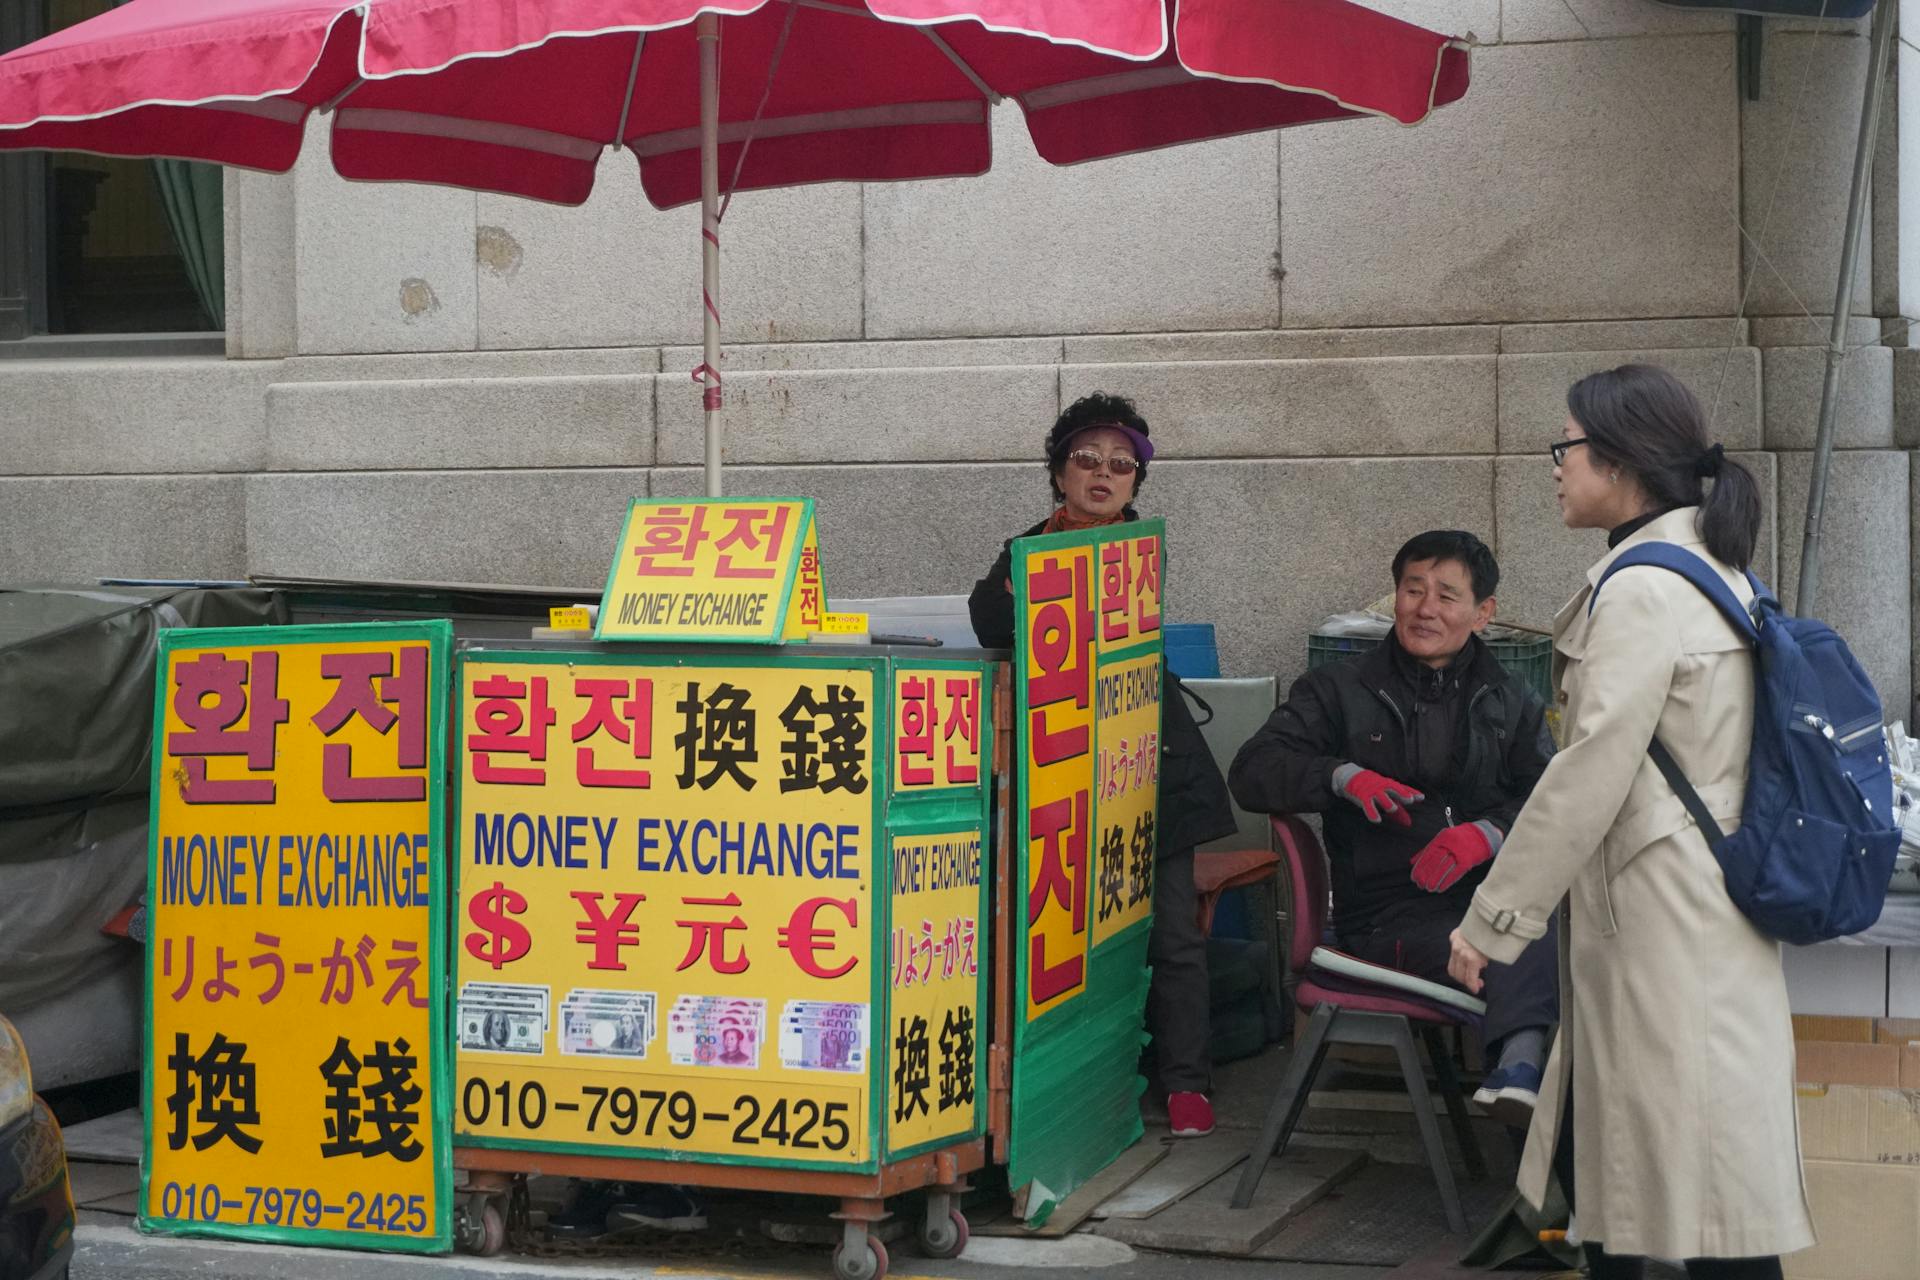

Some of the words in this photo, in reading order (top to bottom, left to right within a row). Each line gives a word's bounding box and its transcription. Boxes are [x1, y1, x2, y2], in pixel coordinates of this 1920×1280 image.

[634, 505, 791, 579] 환전
[618, 592, 678, 625] MONEY
[679, 593, 768, 626] EXCHANGE
[800, 547, 819, 624] 환전
[1102, 536, 1160, 642] 환전
[168, 646, 428, 804] 환전
[1098, 672, 1124, 720] MONEY
[1127, 662, 1159, 711] EXCHANG
[468, 675, 653, 789] 환전
[899, 676, 979, 787] 환전
[1028, 555, 1095, 1005] 환전
[162, 834, 270, 906] MONEY
[278, 832, 429, 908] EXCHANGE
[475, 813, 618, 870] MONEY
[638, 818, 859, 879] EXCHANGE
[892, 847, 928, 896] MONEY
[932, 840, 981, 889] EXCHANGE
[465, 882, 532, 970] $
[675, 892, 750, 974] 元
[777, 897, 859, 979] €
[167, 1033, 424, 1161] 換錢
[895, 1006, 975, 1123] 換錢
[463, 1077, 850, 1150] 010-7979-2425
[162, 1182, 427, 1232] 010-7979-2425
